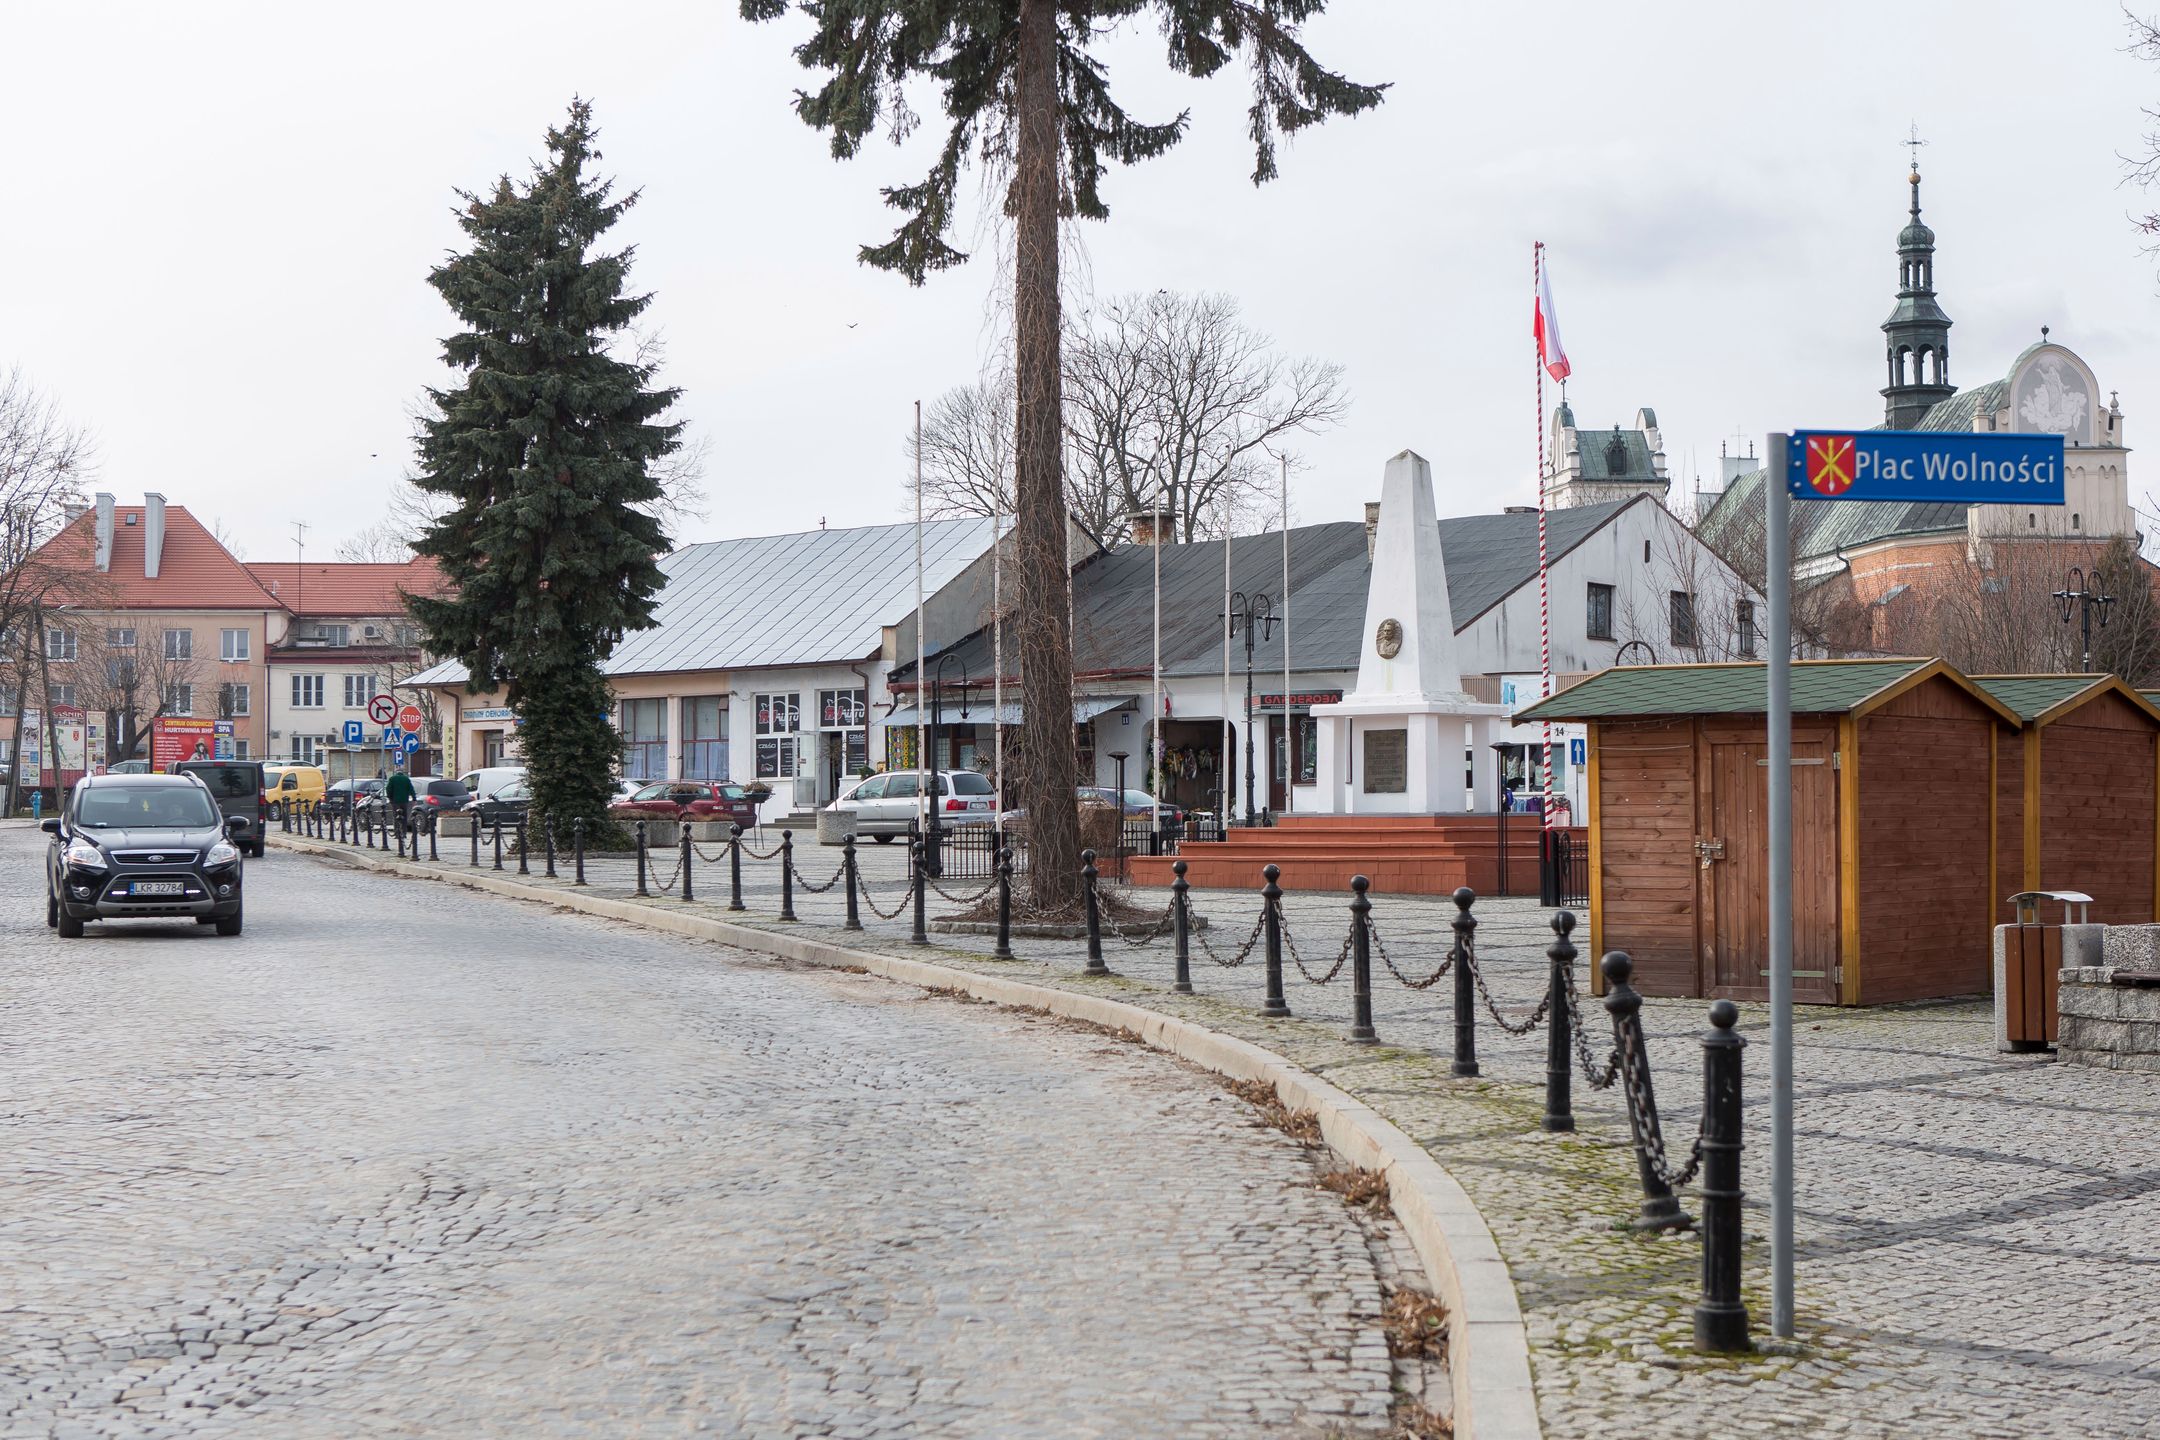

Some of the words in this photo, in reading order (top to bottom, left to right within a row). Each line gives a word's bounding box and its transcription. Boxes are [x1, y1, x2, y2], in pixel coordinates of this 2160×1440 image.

[1855, 449, 1914, 480] Plac
[1922, 452, 2054, 483] Wolności
[401, 714, 421, 723] STOP
[348, 723, 359, 741] P
[1555, 727, 1564, 736] 14
[395, 751, 402, 764] P
[135, 883, 153, 893] LKR
[155, 883, 183, 893] 32784
